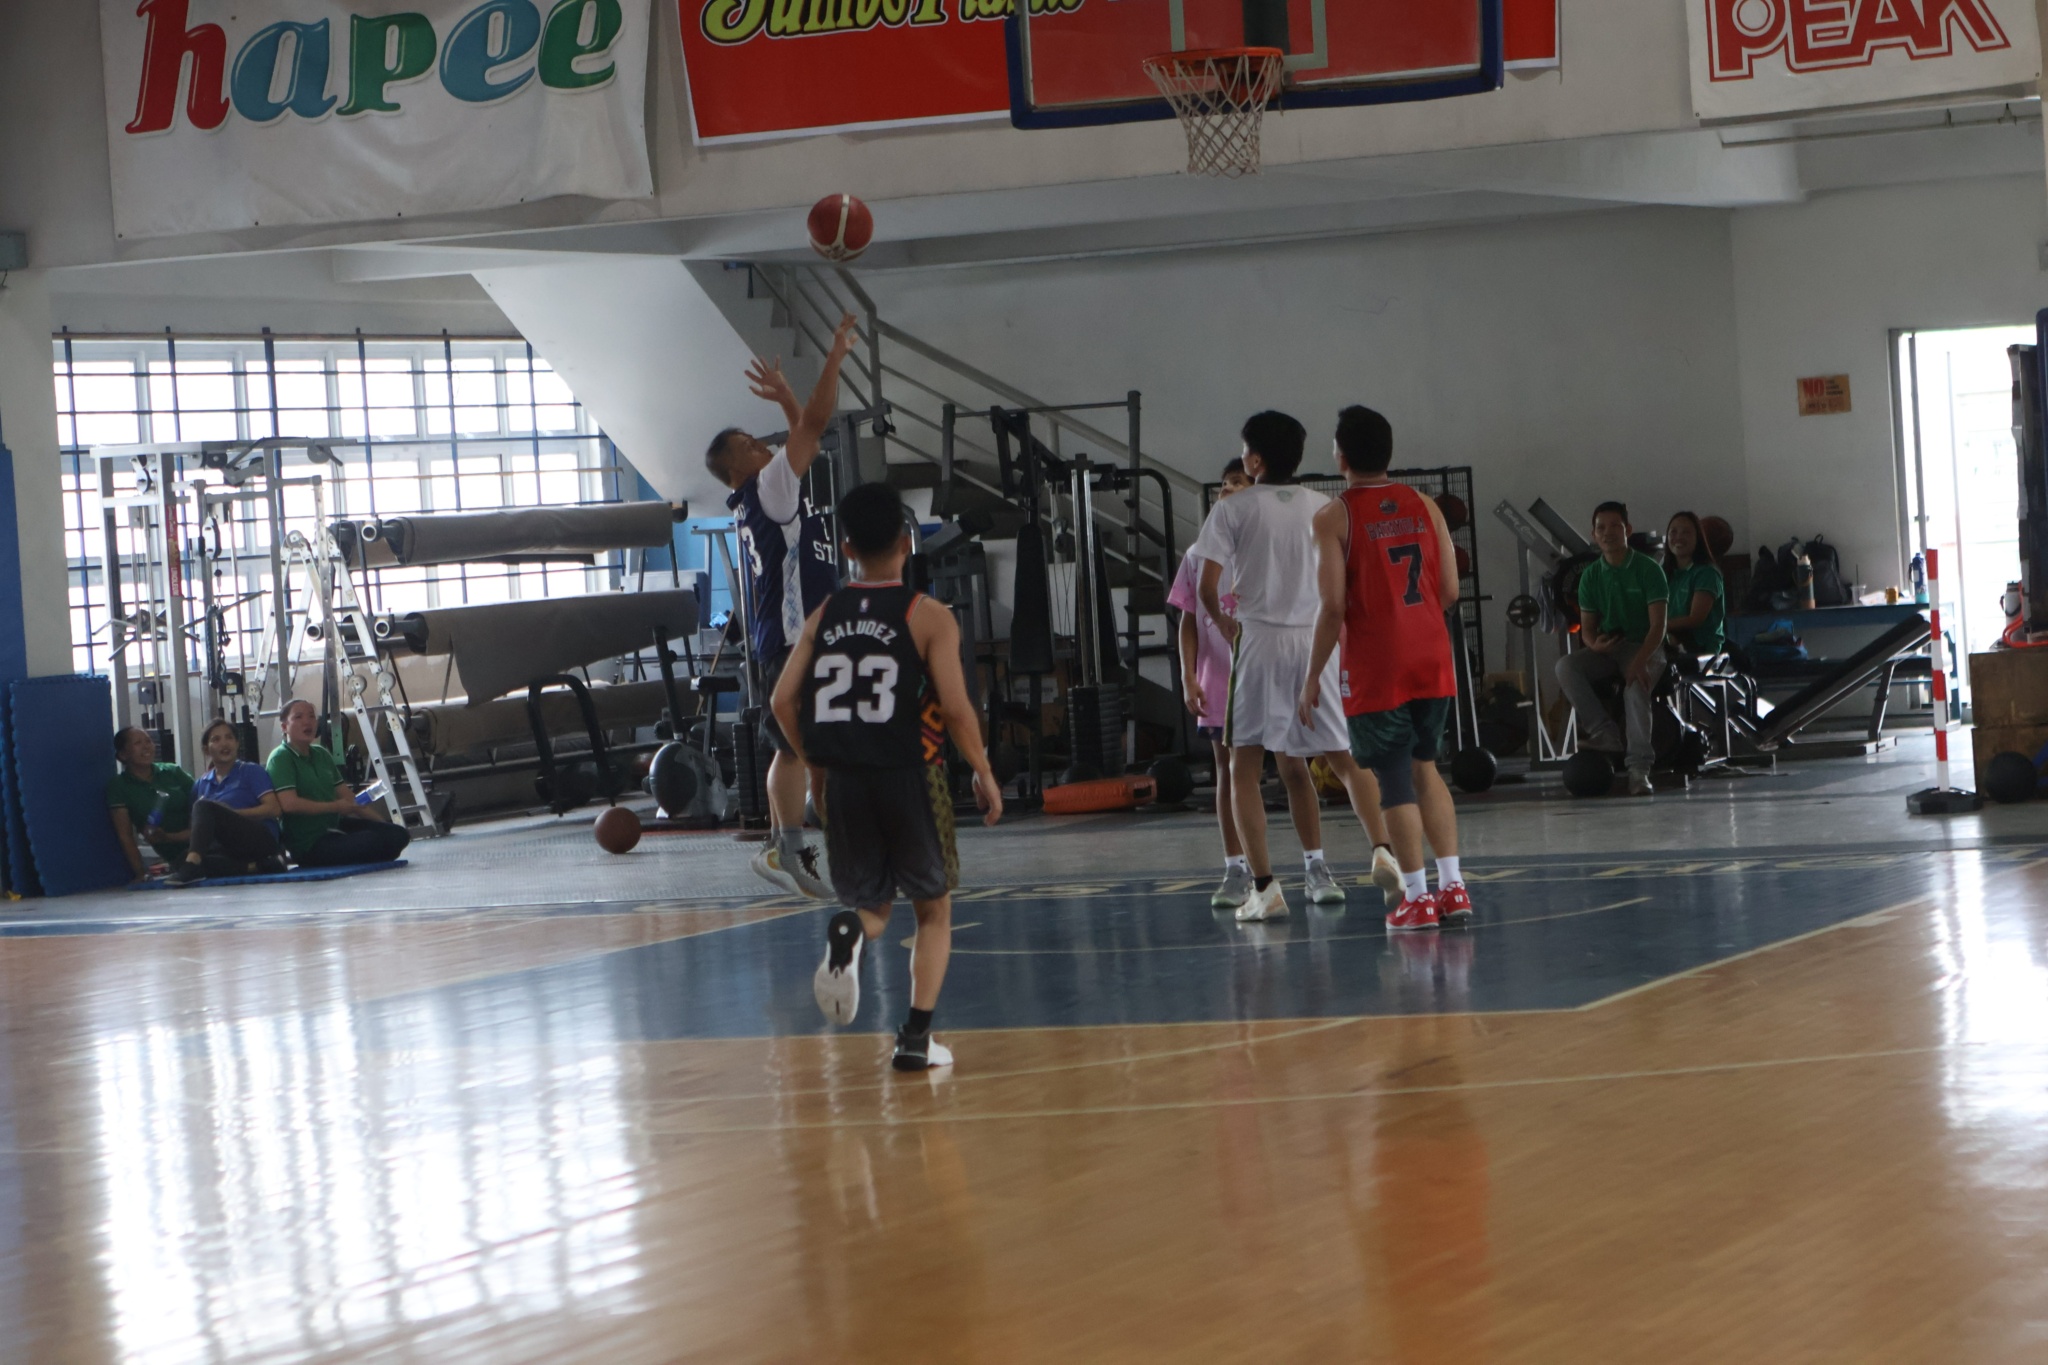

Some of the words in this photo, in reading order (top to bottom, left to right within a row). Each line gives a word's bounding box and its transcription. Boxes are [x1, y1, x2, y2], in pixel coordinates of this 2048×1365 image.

[125, 0, 622, 134] hapee
[1387, 543, 1424, 607] 7
[823, 620, 898, 646] SALUDEZ
[814, 654, 899, 723] 23
